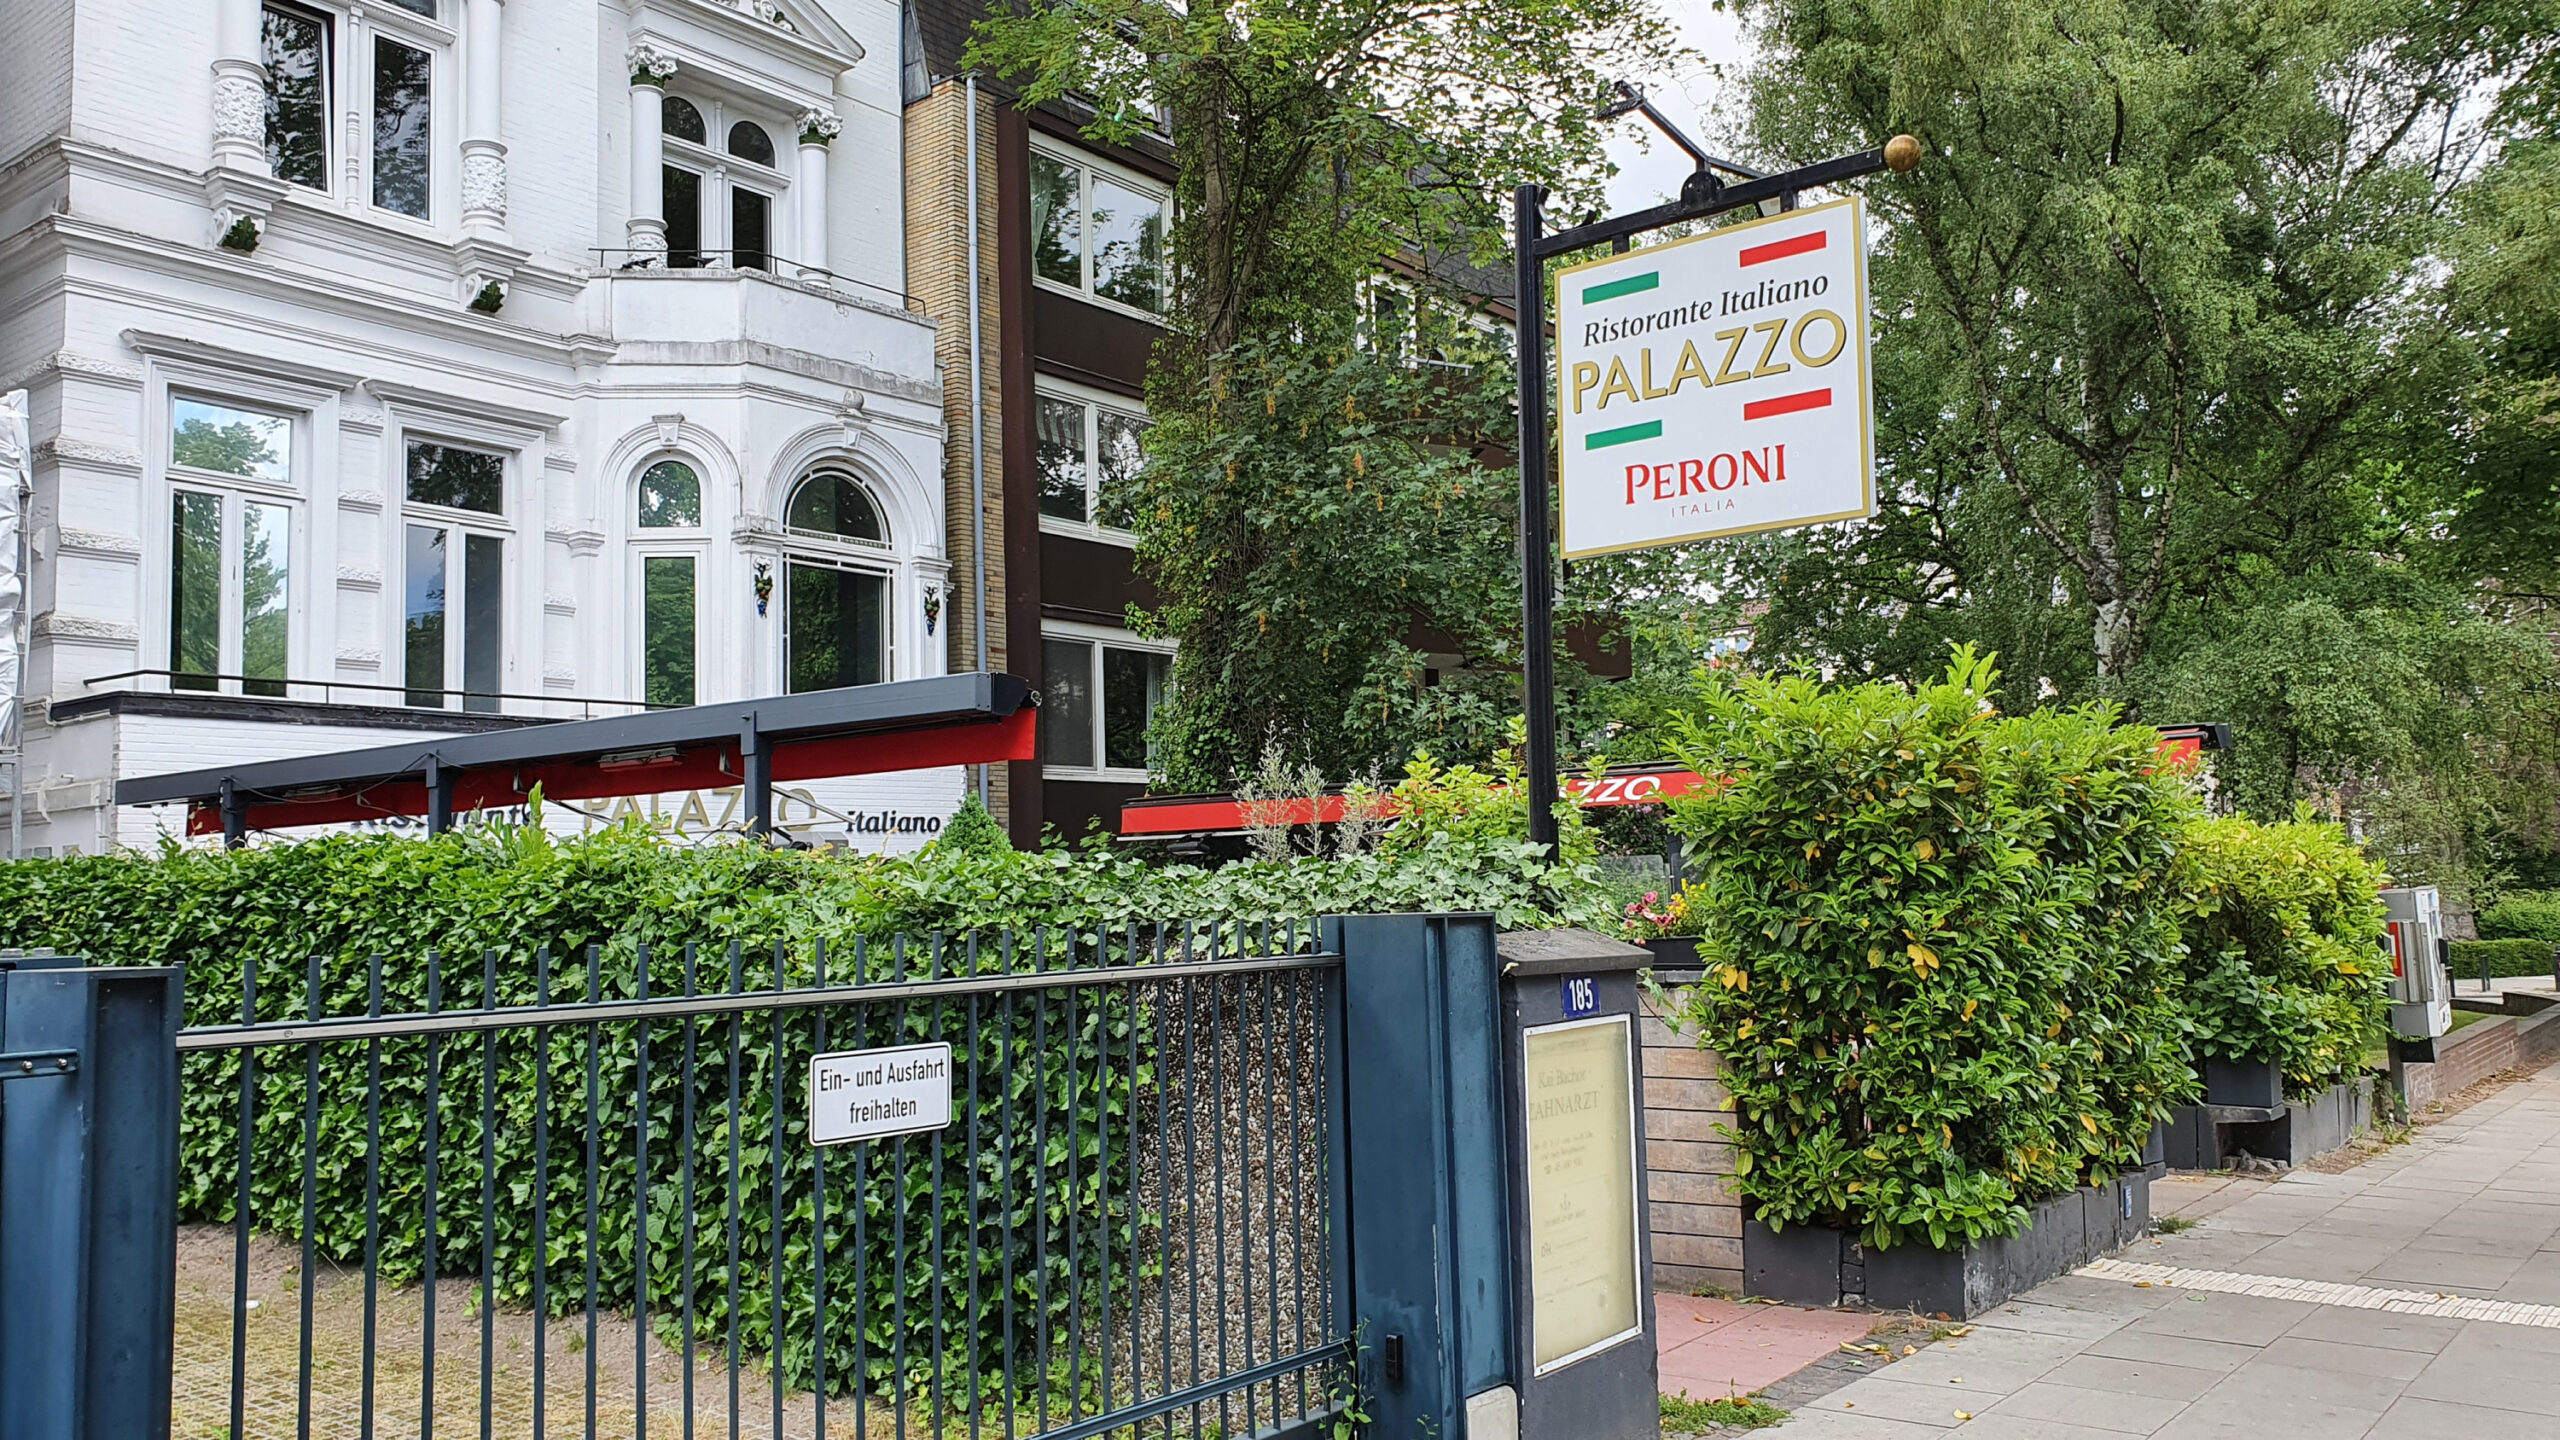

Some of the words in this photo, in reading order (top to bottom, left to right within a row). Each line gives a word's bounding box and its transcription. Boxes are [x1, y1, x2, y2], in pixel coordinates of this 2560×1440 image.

[1582, 299, 1712, 347] Ristorante
[1719, 275, 1828, 317] Italiano
[1572, 309, 1846, 414] PALAZZO
[1624, 444, 1786, 505] PERONI
[1671, 498, 1735, 518] ITALIA
[583, 786, 818, 832] PALAZO
[845, 810, 941, 834] Italiano
[1569, 978, 1594, 1011] 185
[820, 1068, 851, 1092] Ein-
[856, 1064, 882, 1087] und
[887, 1058, 945, 1084] Ausfahrt
[849, 1097, 917, 1124] freihalten
